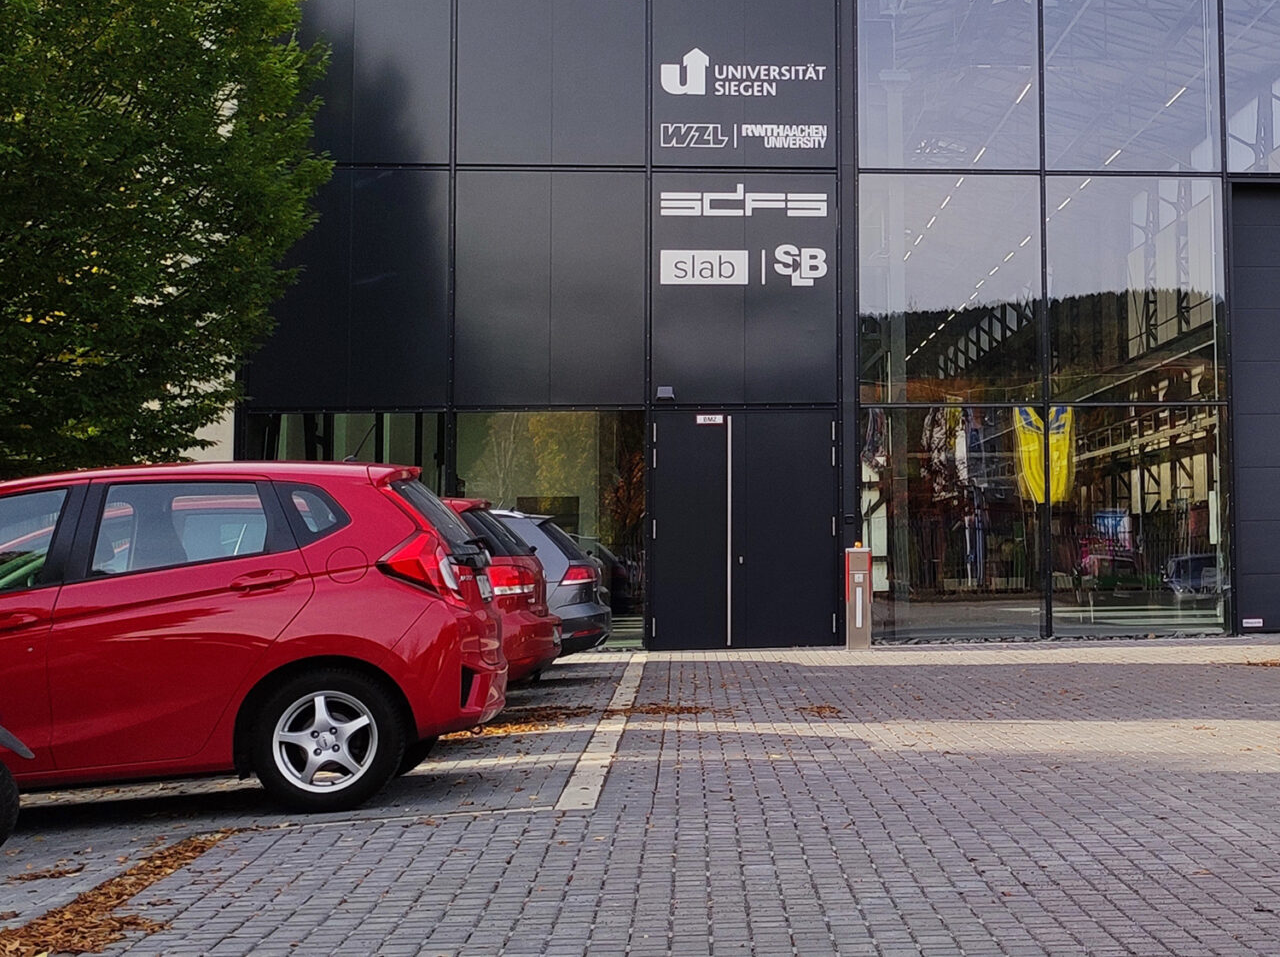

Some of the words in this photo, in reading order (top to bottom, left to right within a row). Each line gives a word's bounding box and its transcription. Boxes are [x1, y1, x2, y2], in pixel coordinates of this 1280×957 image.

[714, 63, 827, 81] UNIVERSITÄT
[714, 81, 777, 96] SIEGEN
[660, 123, 729, 148] WZL
[764, 136, 827, 149] UNIVERSITY
[674, 254, 736, 279] slab
